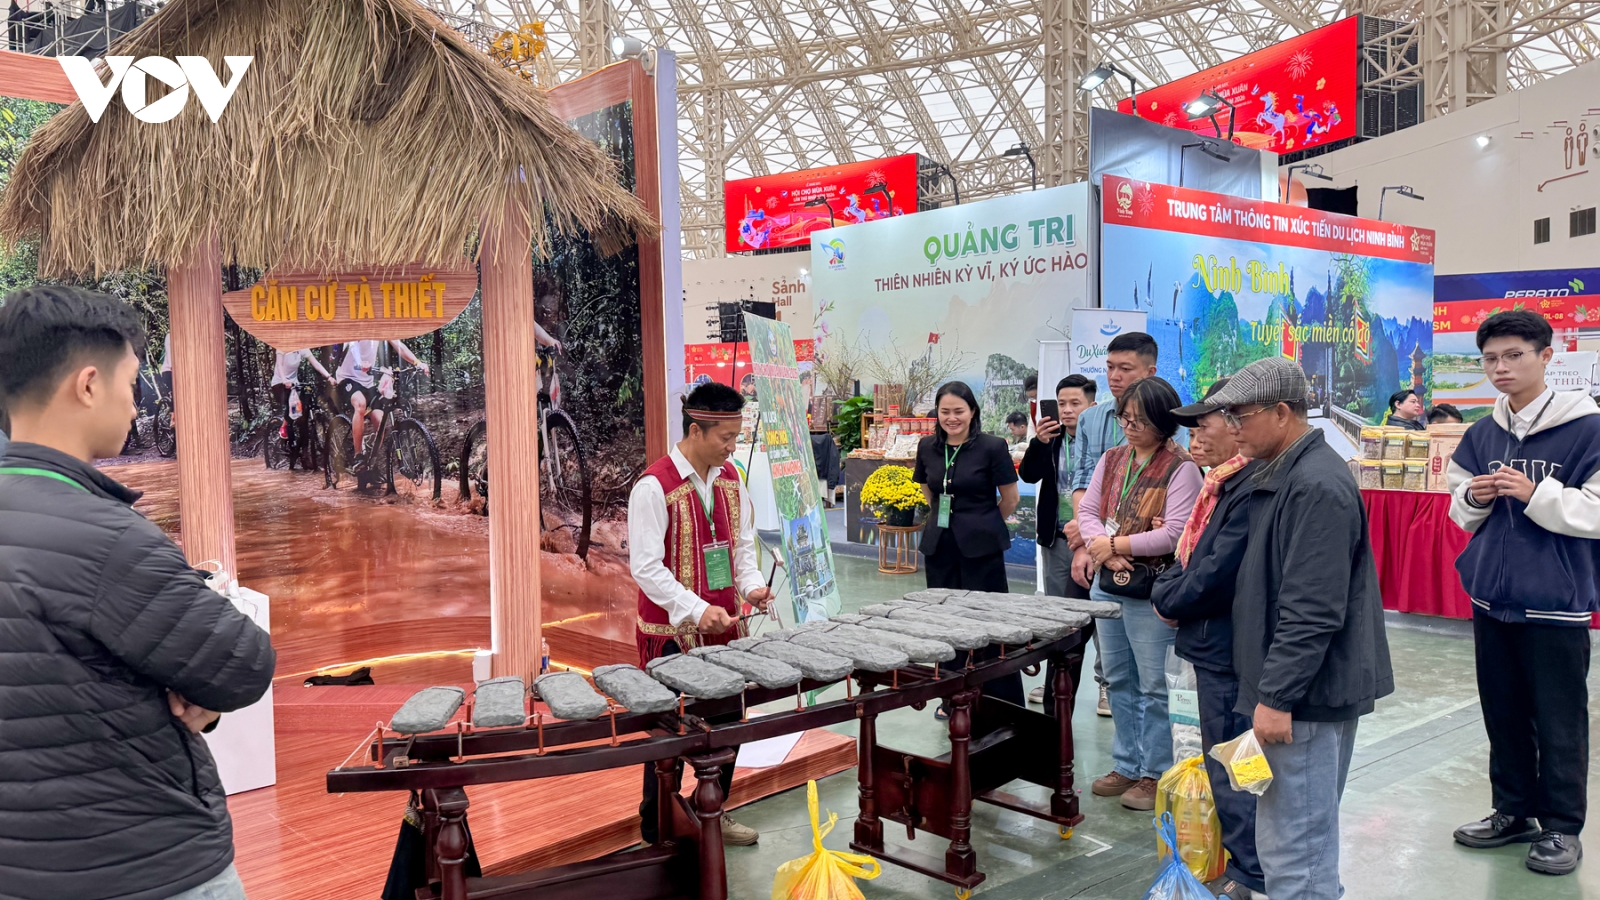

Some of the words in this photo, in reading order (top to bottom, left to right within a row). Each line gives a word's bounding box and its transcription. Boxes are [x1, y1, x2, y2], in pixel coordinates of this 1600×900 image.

[923, 221, 1019, 267] QUẢNG
[1028, 213, 1075, 248] TRỊ
[1167, 198, 1207, 221] TRUNG
[1209, 202, 1232, 225] TÂM
[1234, 207, 1271, 230] THÔNG
[1272, 215, 1289, 233] TIN
[1290, 214, 1310, 236] XÚC
[1311, 218, 1331, 239] TIẾN
[1332, 222, 1345, 241] DU
[1346, 227, 1365, 247] LỊCH
[1366, 230, 1386, 247] NINH
[1387, 230, 1405, 249] BÌNH
[772, 279, 806, 295] Sảnh
[874, 272, 909, 292] THIÊN
[912, 267, 951, 287] NHIÊN
[955, 263, 973, 283] KỲ
[977, 261, 996, 282] VĨ,
[999, 258, 1019, 278] KÝ
[1023, 255, 1046, 275] ỨC
[1051, 250, 1088, 272] HÀO
[1191, 253, 1242, 295] Ninh
[1246, 259, 1290, 297] Bình
[251, 279, 298, 322] CĂN
[345, 276, 375, 319] TÀ
[380, 273, 446, 319] THIẾT
[772, 295, 792, 307] Hall
[1251, 320, 1286, 347] Tuyệt
[1287, 312, 1309, 342] sắc
[1312, 312, 1340, 343] miền
[1076, 344, 1091, 359] Du
